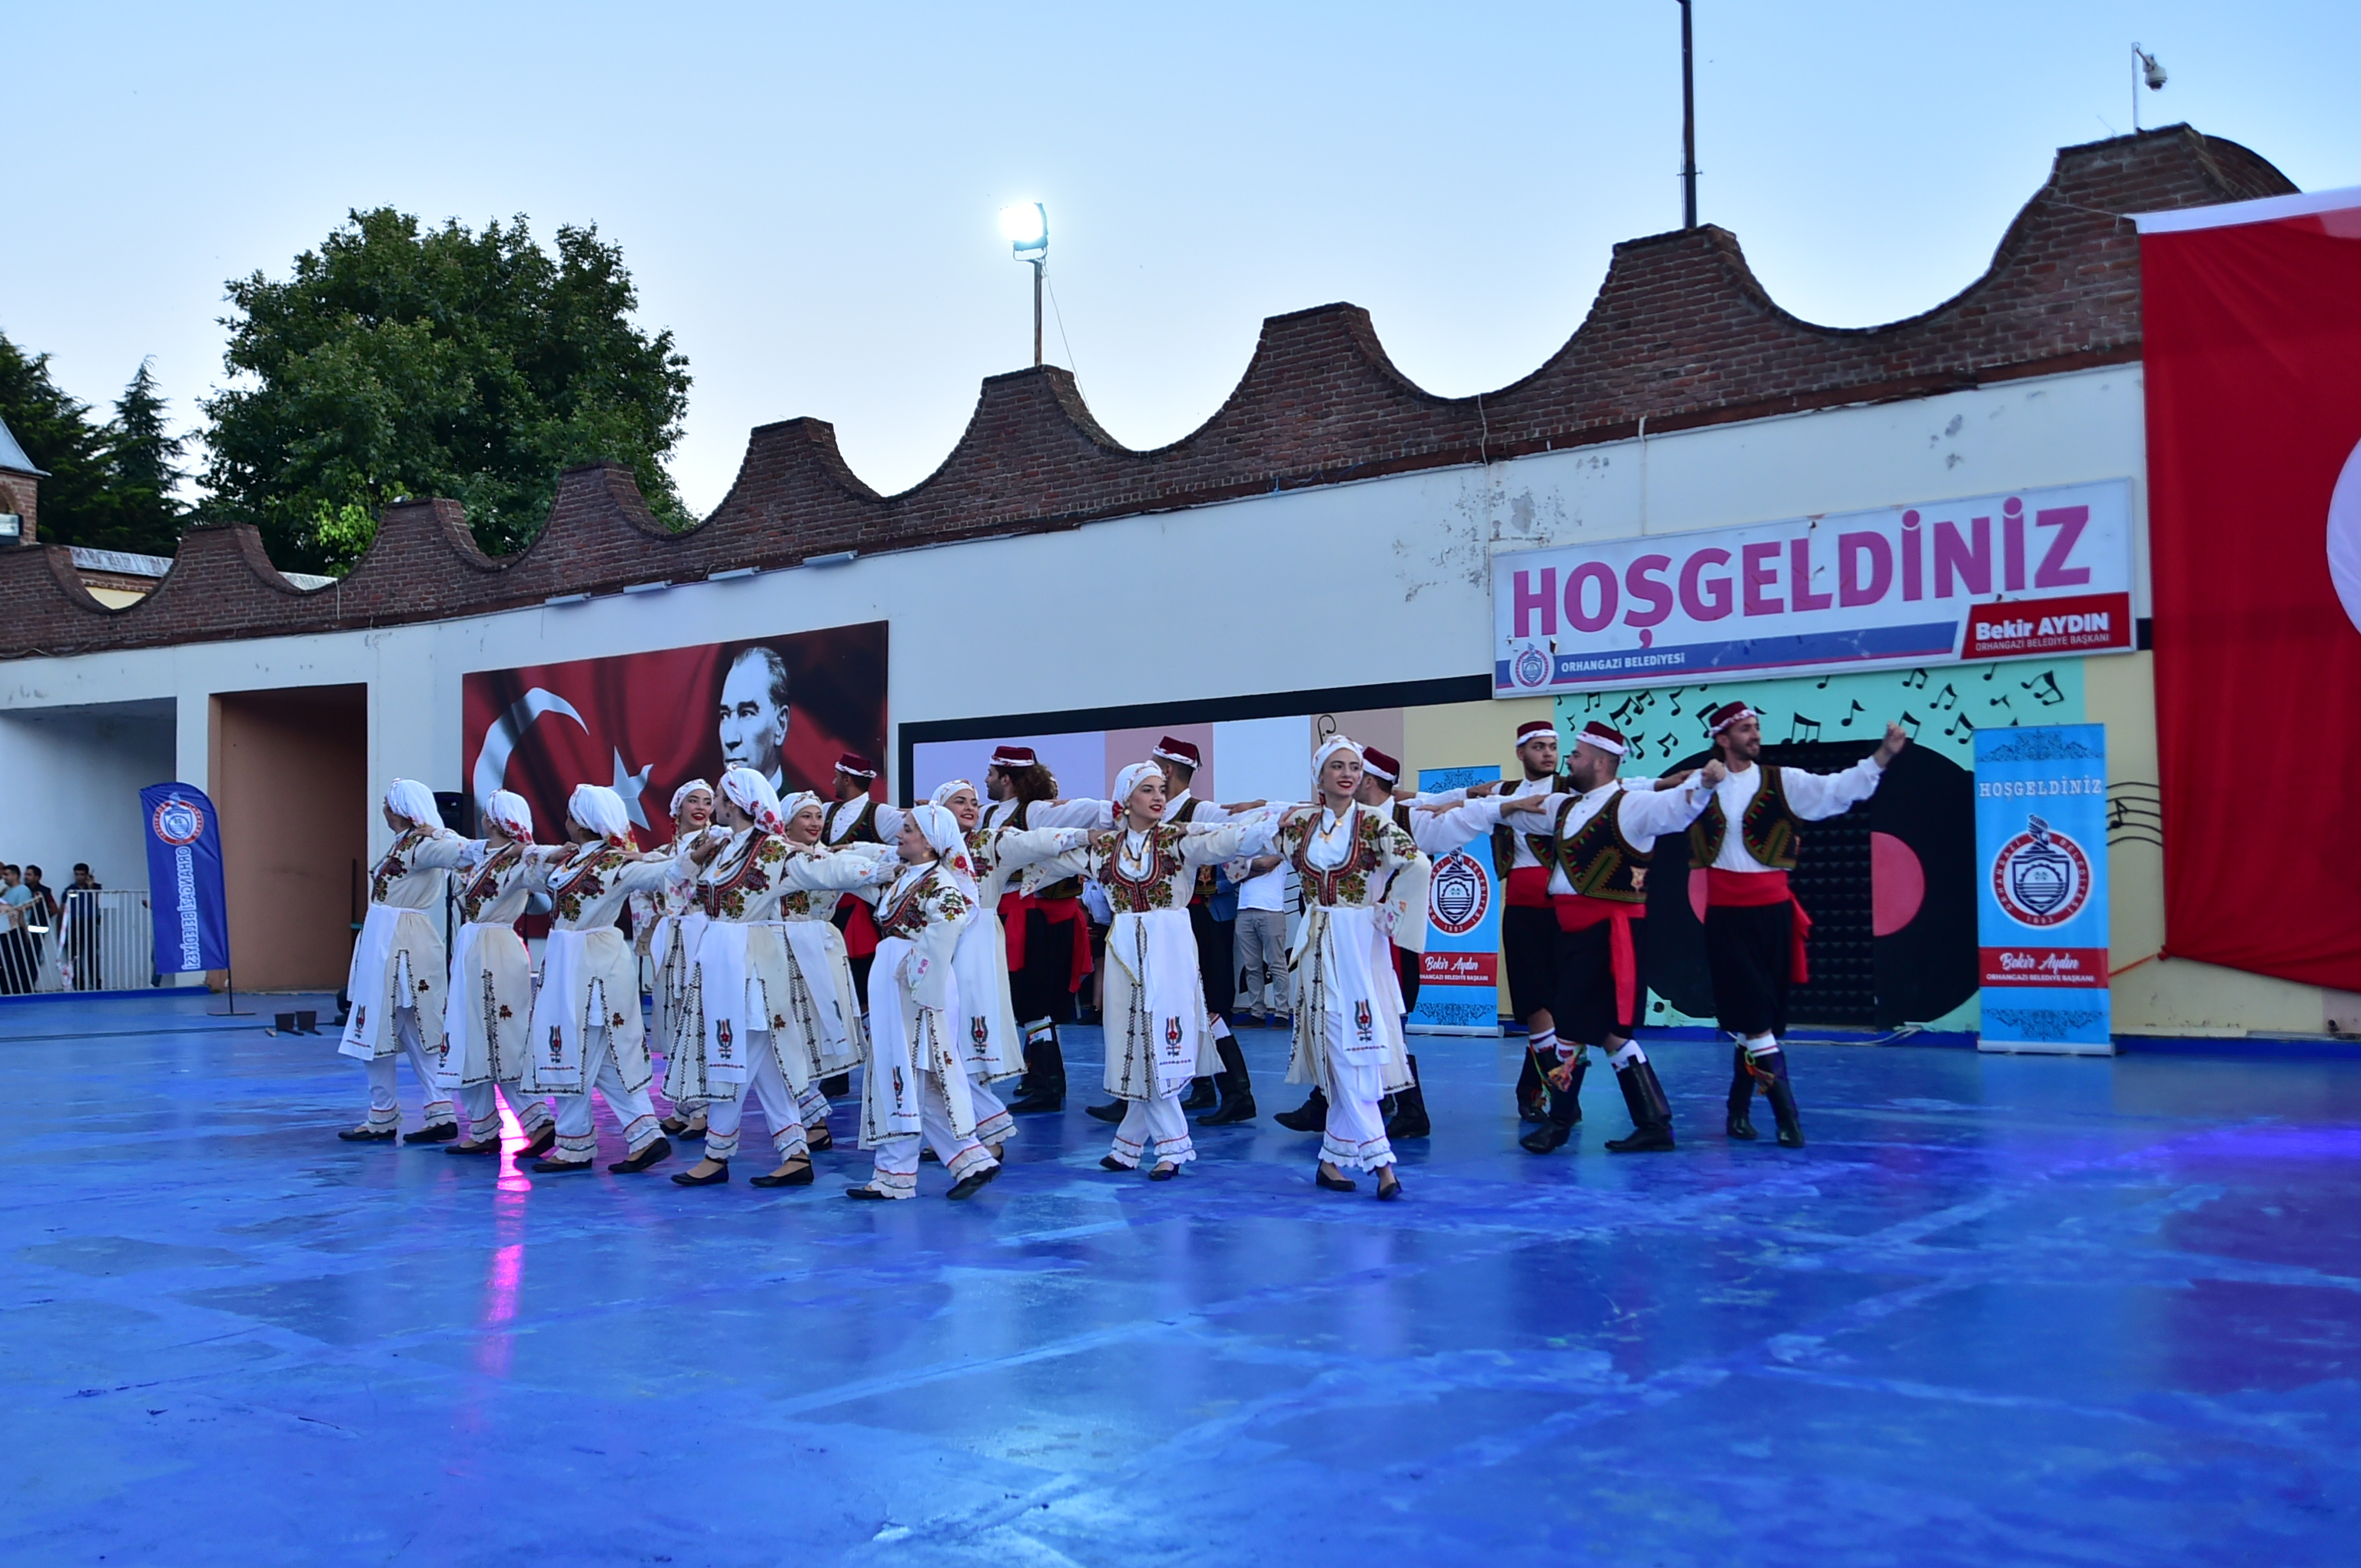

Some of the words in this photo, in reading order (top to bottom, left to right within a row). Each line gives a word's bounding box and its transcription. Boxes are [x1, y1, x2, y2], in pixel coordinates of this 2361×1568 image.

[1513, 496, 2091, 649] HOŞGELDİNİZ
[1976, 619, 2034, 640] Bekir
[2037, 612, 2109, 636] AYDIN
[2070, 633, 2110, 646] BAŞKANI
[1561, 662, 1622, 673] ORHANGAZİ
[1624, 653, 1685, 668] BELEDİYESİ
[1978, 775, 2102, 802] HOŞGELDİNİZ
[1424, 955, 1449, 972] Bekir
[1999, 952, 2035, 971] Bekir
